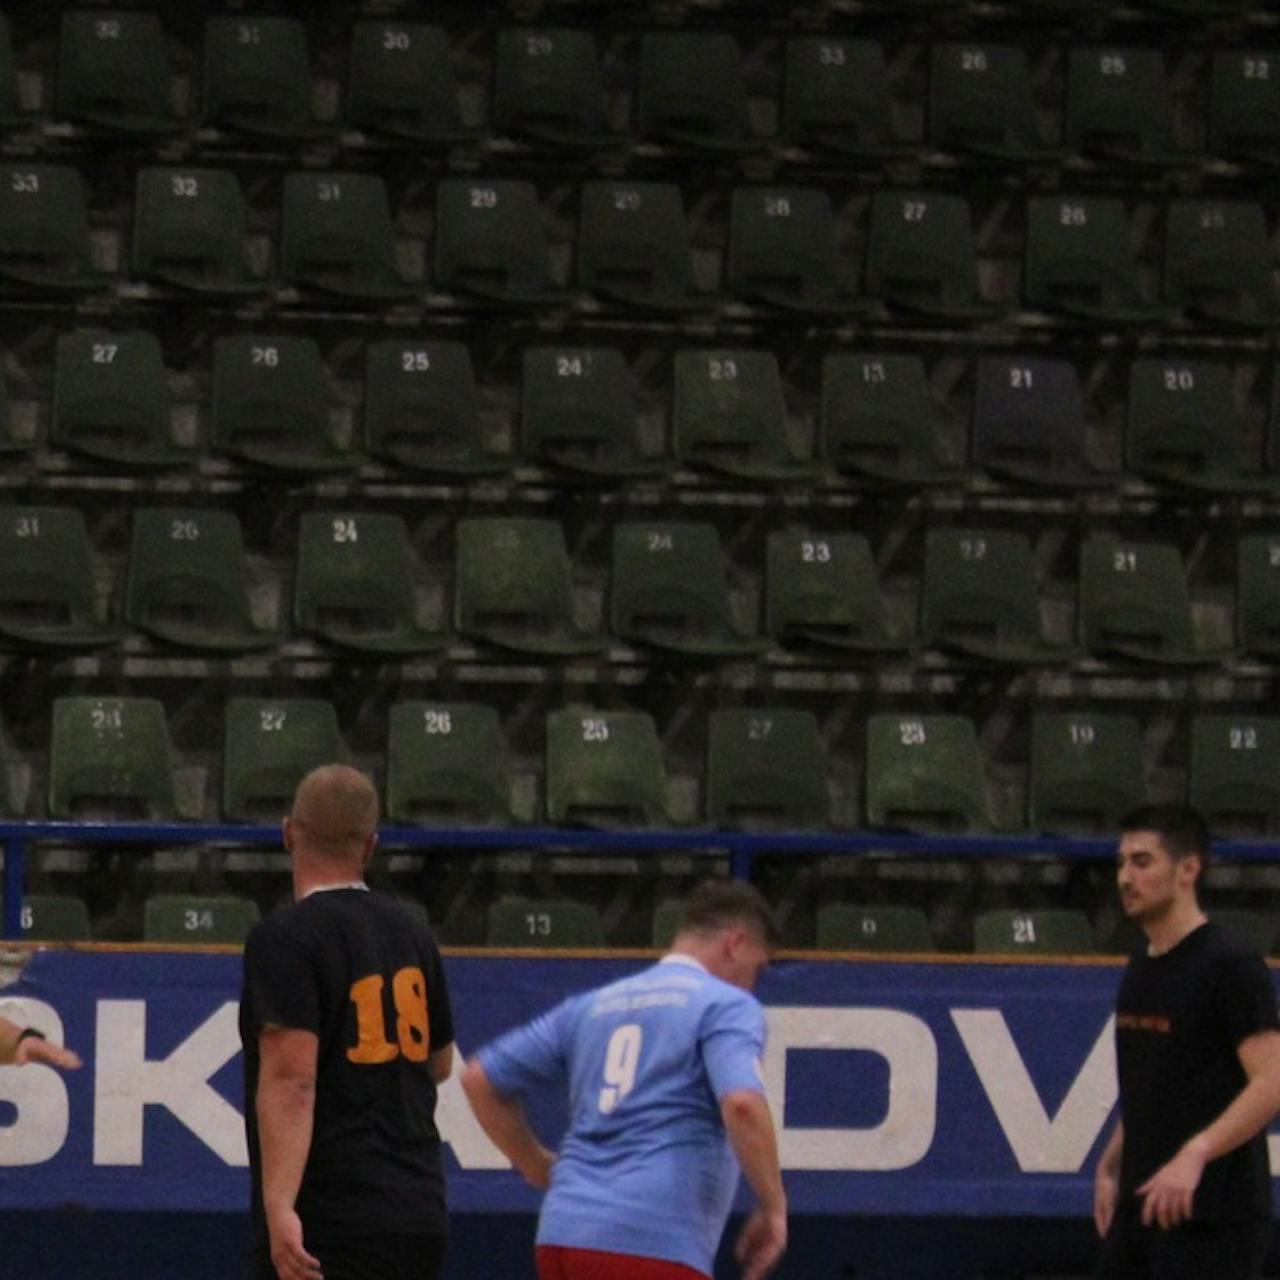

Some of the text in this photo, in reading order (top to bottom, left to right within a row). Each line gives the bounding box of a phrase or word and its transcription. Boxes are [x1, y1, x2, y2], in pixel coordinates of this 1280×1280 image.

[383, 31, 410, 51] 30
[819, 46, 846, 66] 33
[171, 175, 198, 196] 32
[317, 182, 341, 202] 31
[903, 202, 928, 221] 27
[92, 343, 118, 363] 27
[251, 346, 278, 367] 26
[403, 351, 429, 371] 25
[557, 357, 582, 377] 24
[1009, 367, 1033, 388] 21
[1164, 368, 1193, 390] 20
[15, 518, 38, 538] 31
[333, 519, 358, 542] 24
[801, 541, 830, 562] 23
[1113, 550, 1137, 571] 21
[261, 709, 287, 731] 27
[185, 909, 215, 930] 34
[526, 914, 551, 935] 13
[1011, 918, 1037, 942] 21
[345, 966, 432, 1064] 18
[598, 1024, 643, 1115] 9
